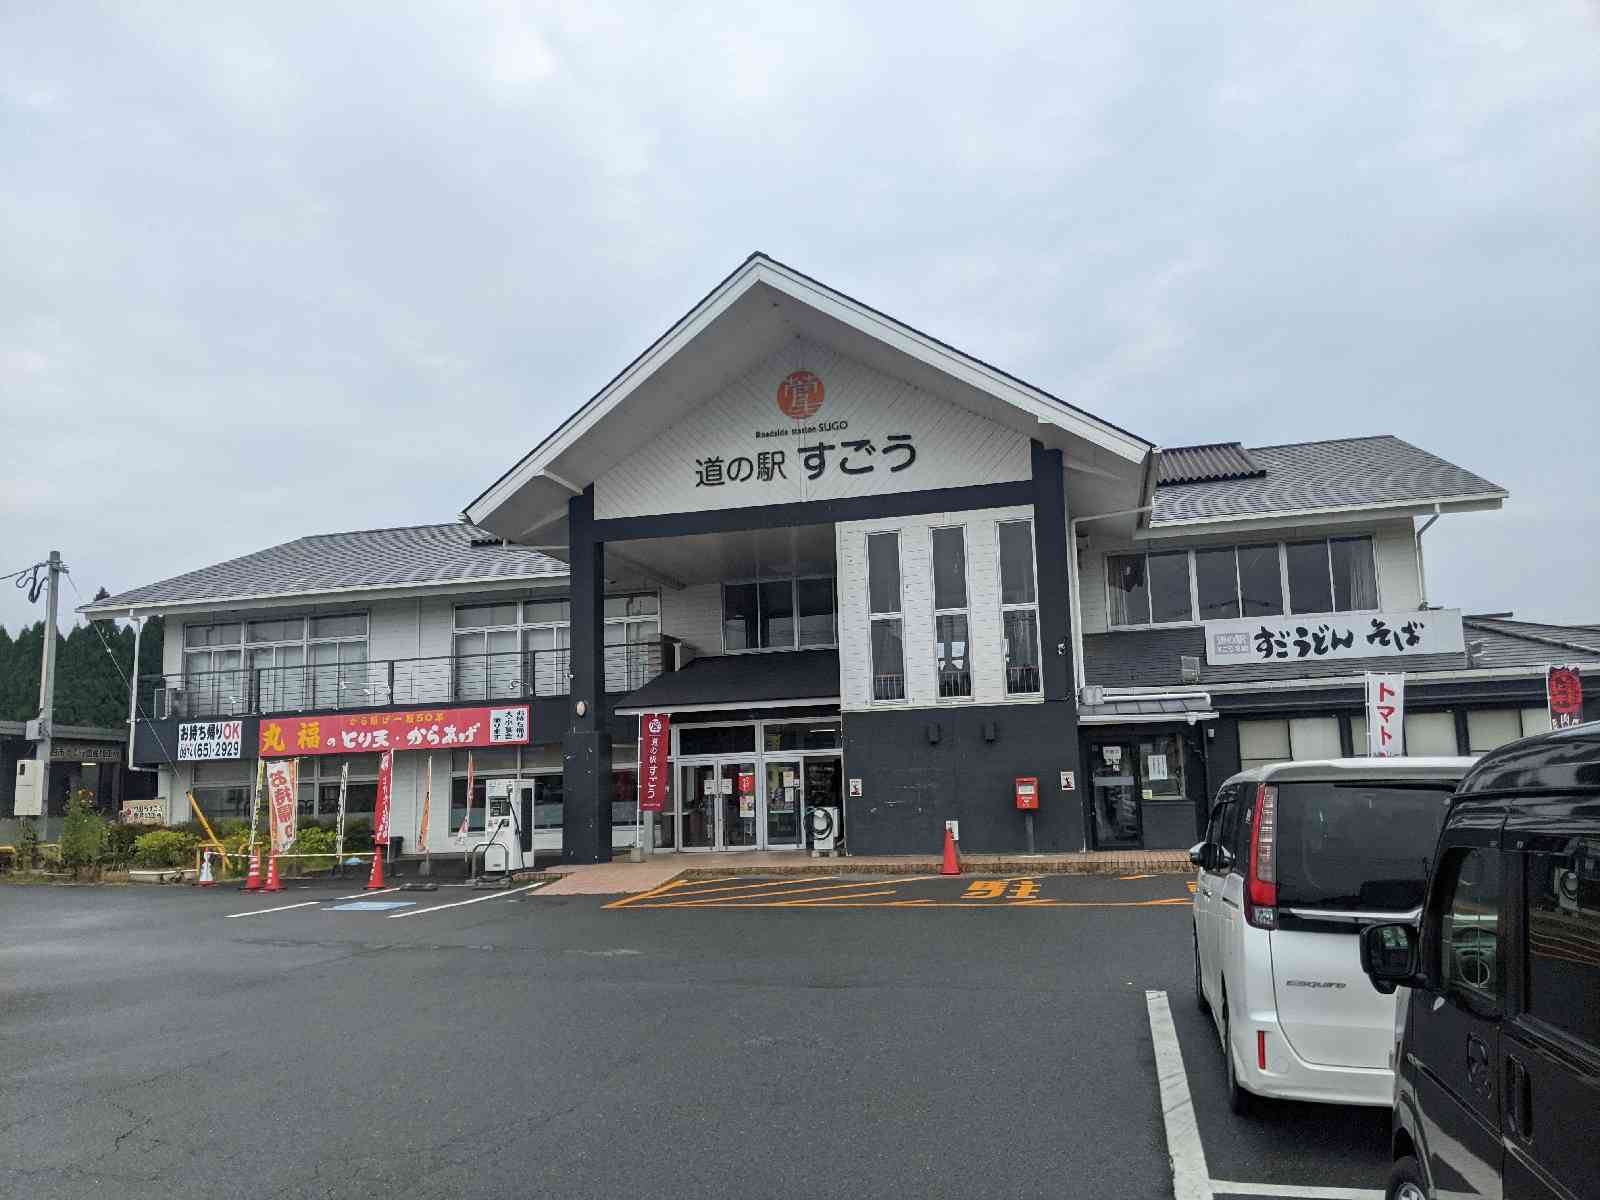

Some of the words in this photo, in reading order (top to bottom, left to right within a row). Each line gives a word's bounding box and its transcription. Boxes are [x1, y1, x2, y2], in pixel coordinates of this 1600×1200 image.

[818, 421, 848, 433] SUGO
[1254, 624, 1354, 658] すごうどん
[1366, 618, 1424, 651] そば
[180, 722, 240, 741] お持ち帰りOK
[1376, 682, 1395, 758] トマト
